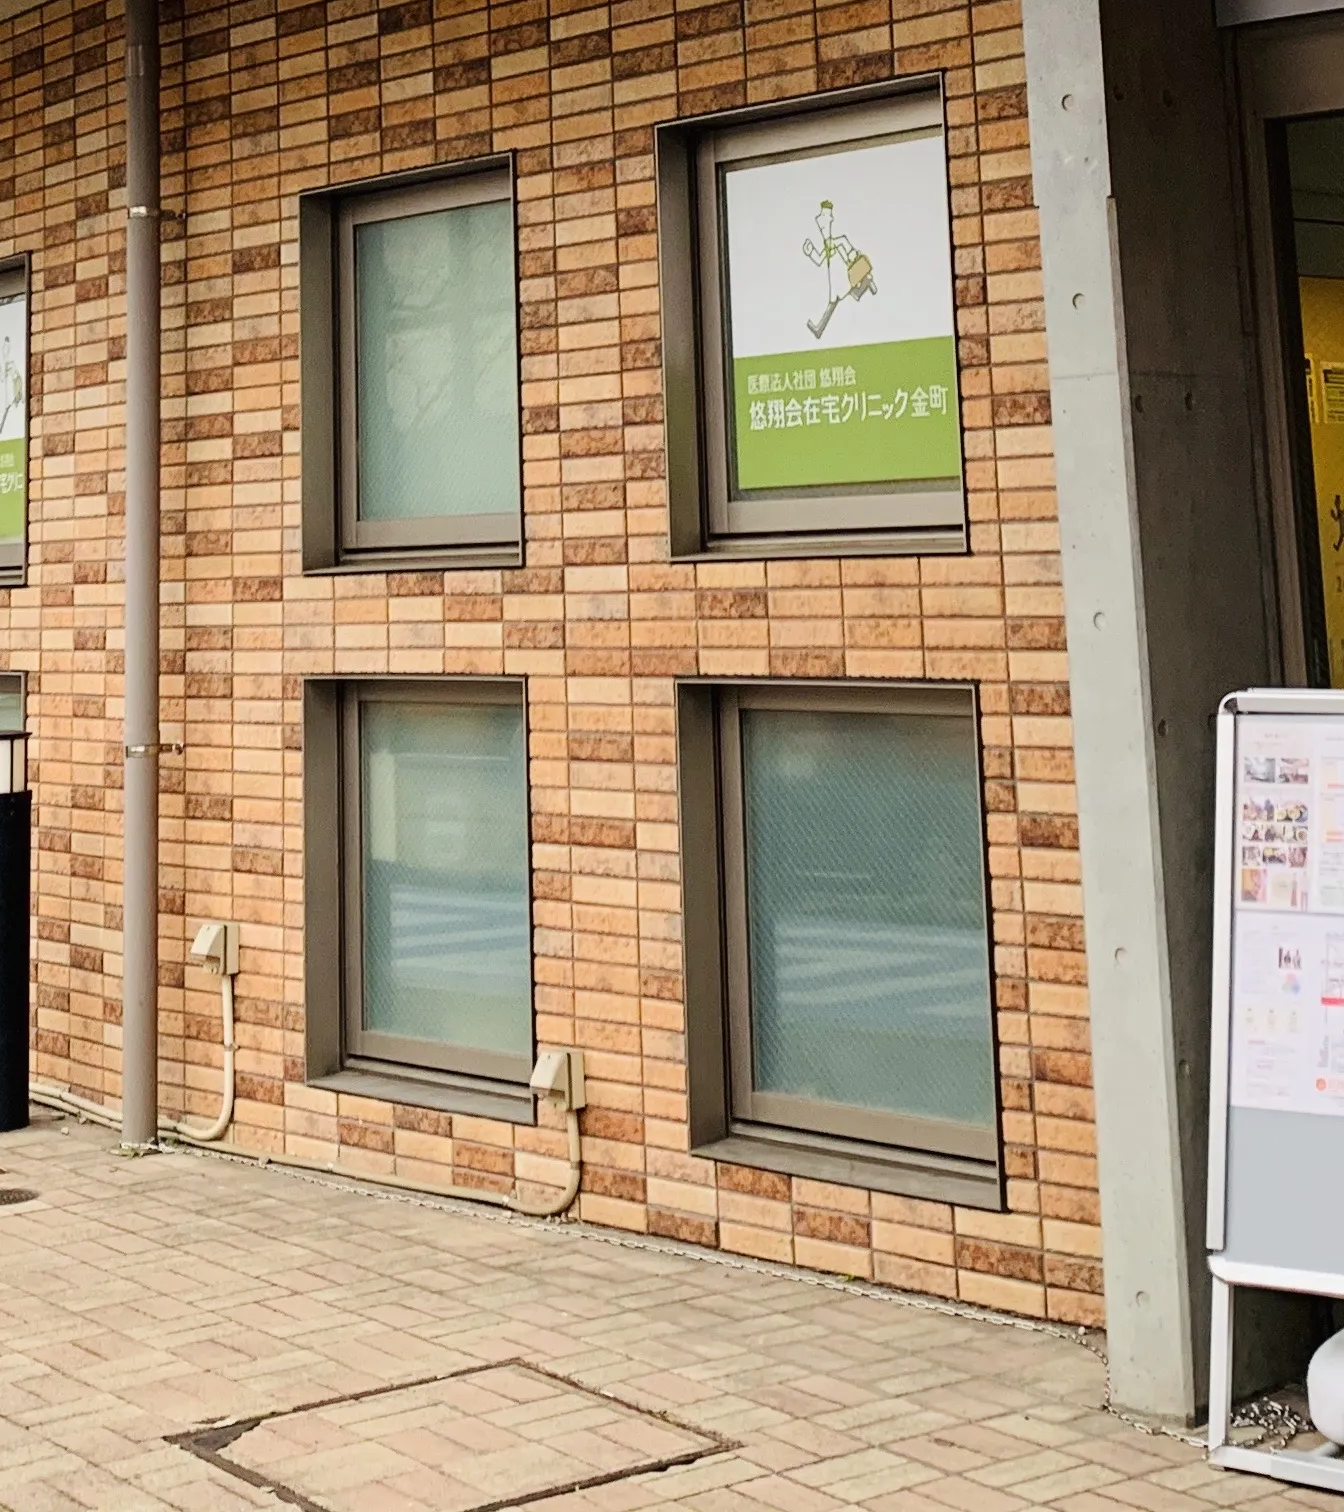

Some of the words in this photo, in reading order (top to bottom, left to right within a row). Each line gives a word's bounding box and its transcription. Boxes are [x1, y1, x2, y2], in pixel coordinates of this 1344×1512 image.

[749, 383, 949, 432] 悠翔会在宅クリニック金町
